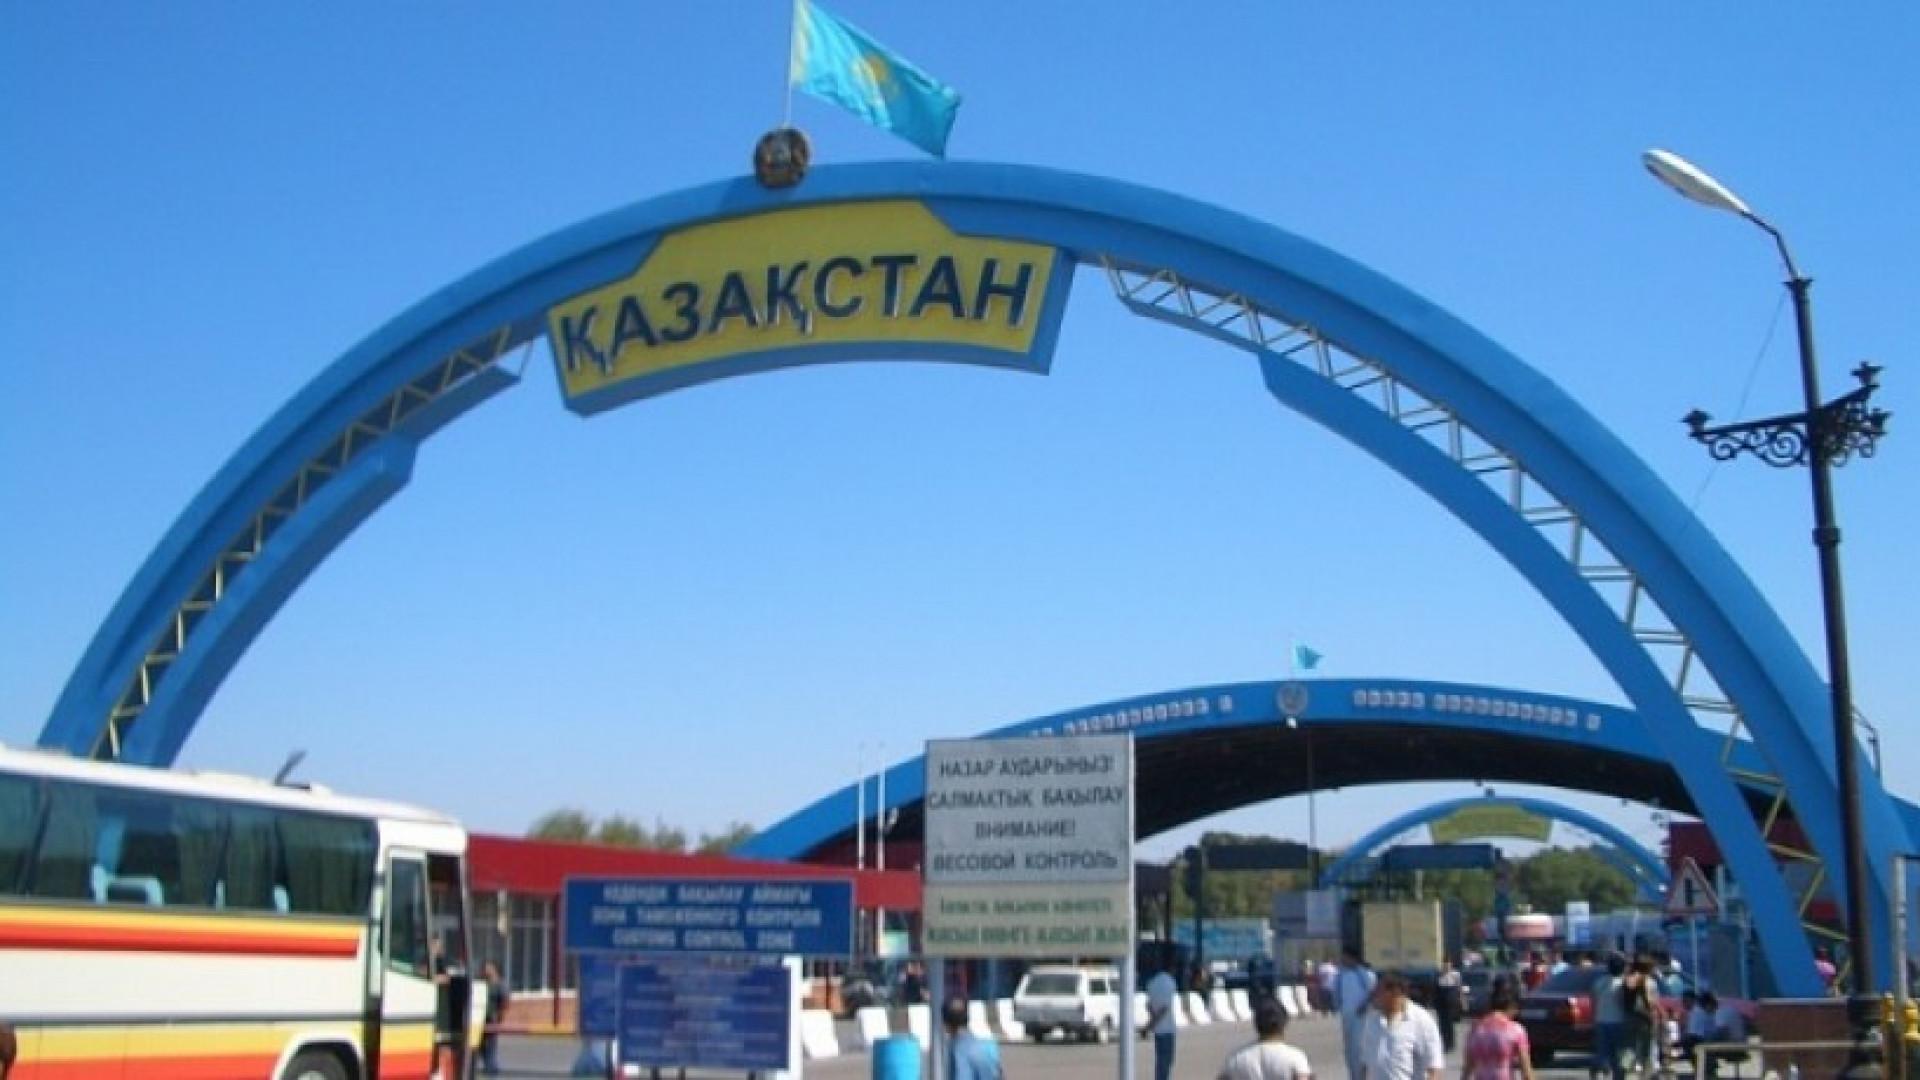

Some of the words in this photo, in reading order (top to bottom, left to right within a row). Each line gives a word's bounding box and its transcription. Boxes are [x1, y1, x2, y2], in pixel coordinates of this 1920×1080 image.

[559, 254, 1034, 374] ҚАЗАҚСТАН
[939, 758, 994, 777] НАЗАР
[974, 819, 1076, 838] ВНИМАНИЕ!
[933, 853, 1014, 871] ВЕСОВОЙ
[1025, 851, 1118, 870] КОНТРОЛЬ
[592, 906, 627, 925] ЗОНА
[684, 928, 746, 948] CONTROL
